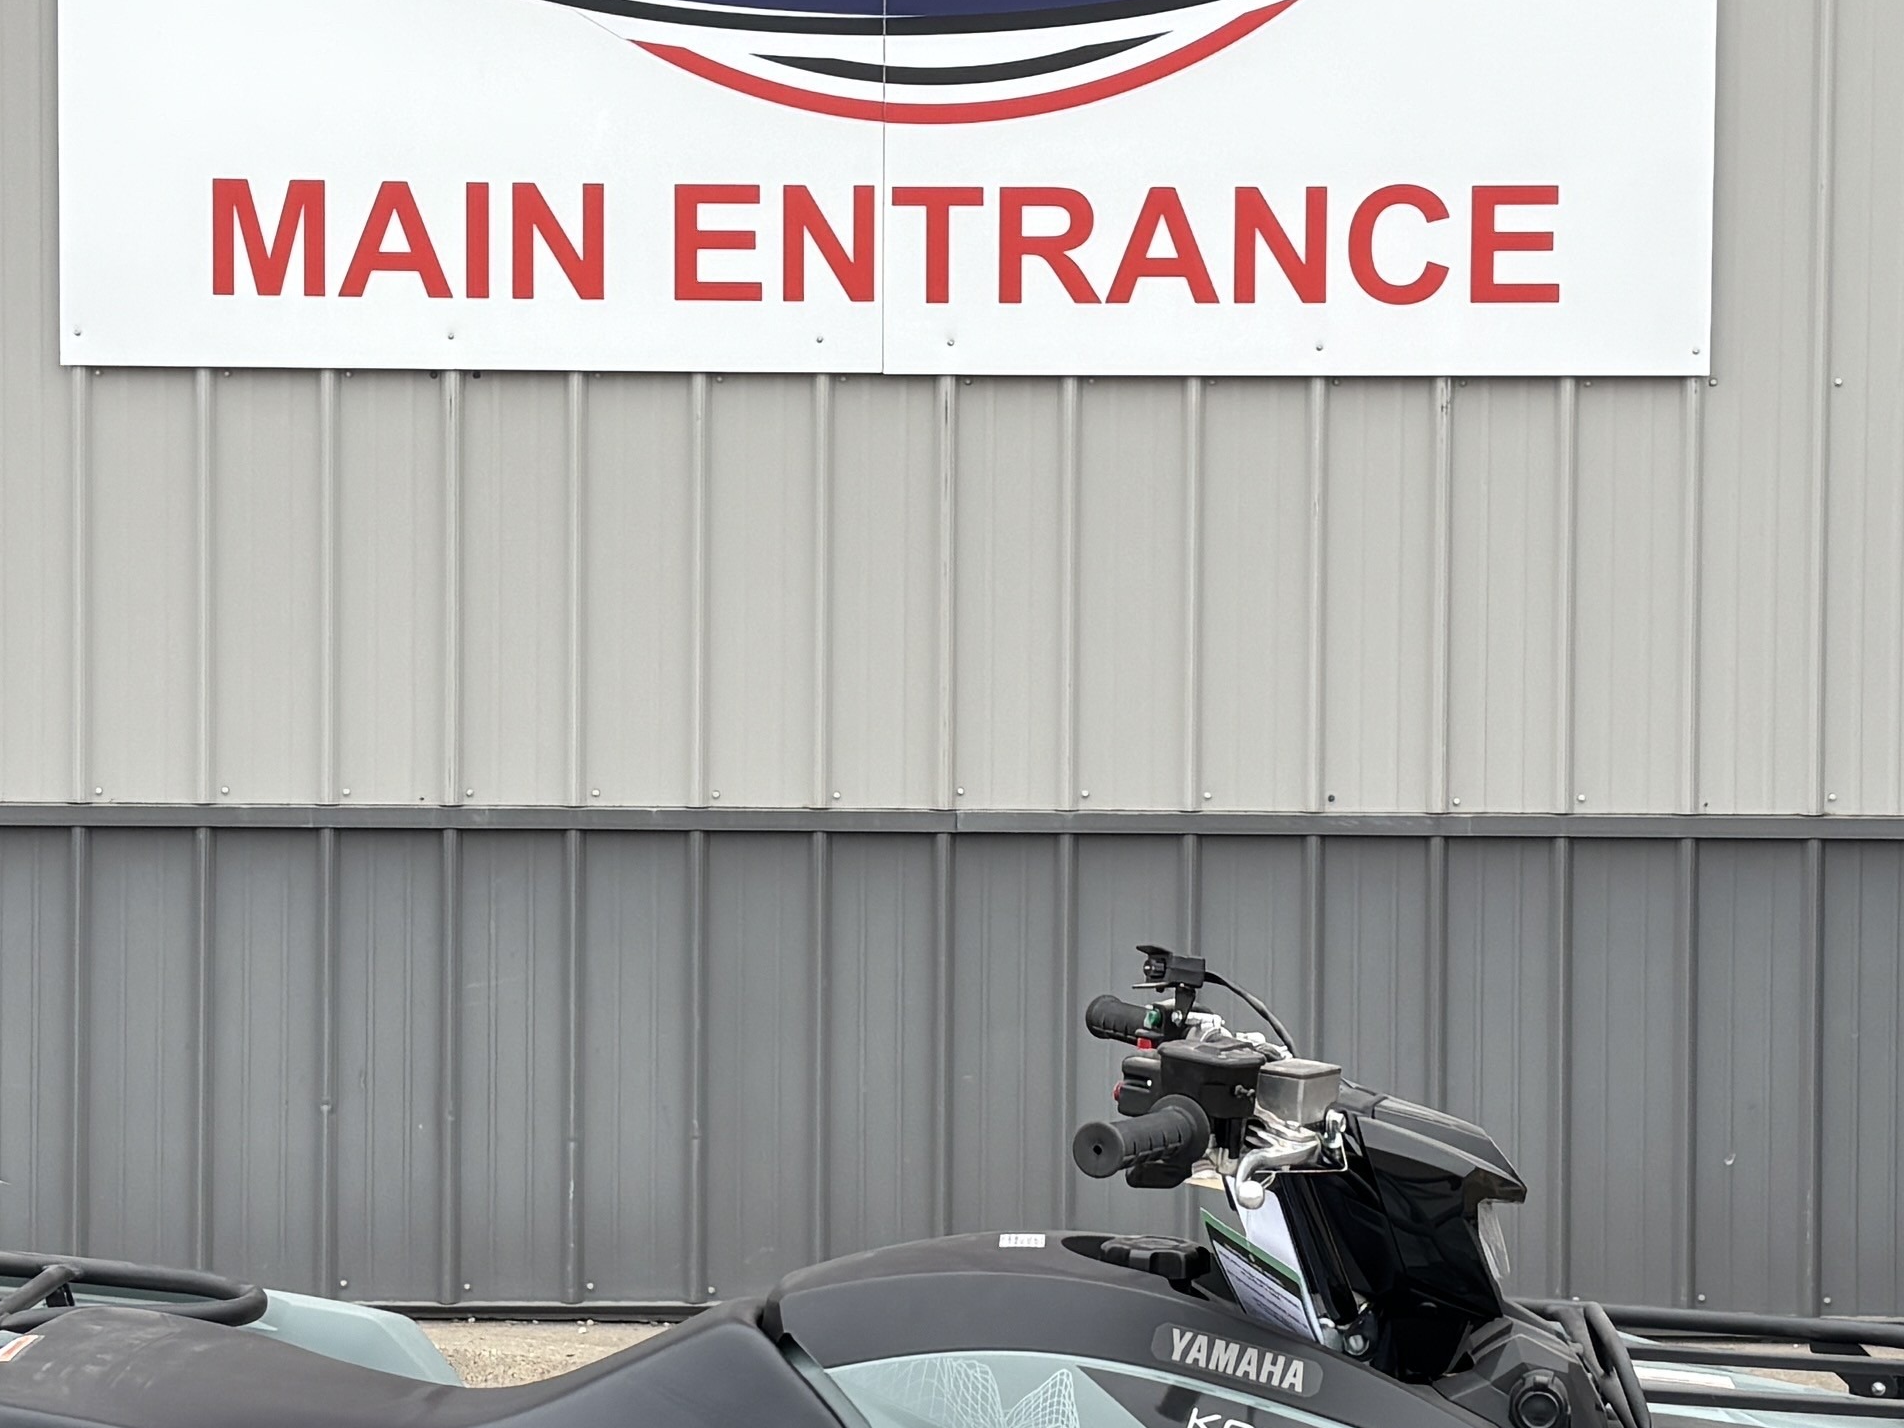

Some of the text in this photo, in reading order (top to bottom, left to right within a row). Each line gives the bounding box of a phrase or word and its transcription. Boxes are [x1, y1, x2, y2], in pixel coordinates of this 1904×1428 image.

[214, 179, 1559, 304] MAIN ENTRANCE
[1169, 1327, 1306, 1393] YAMAHA
